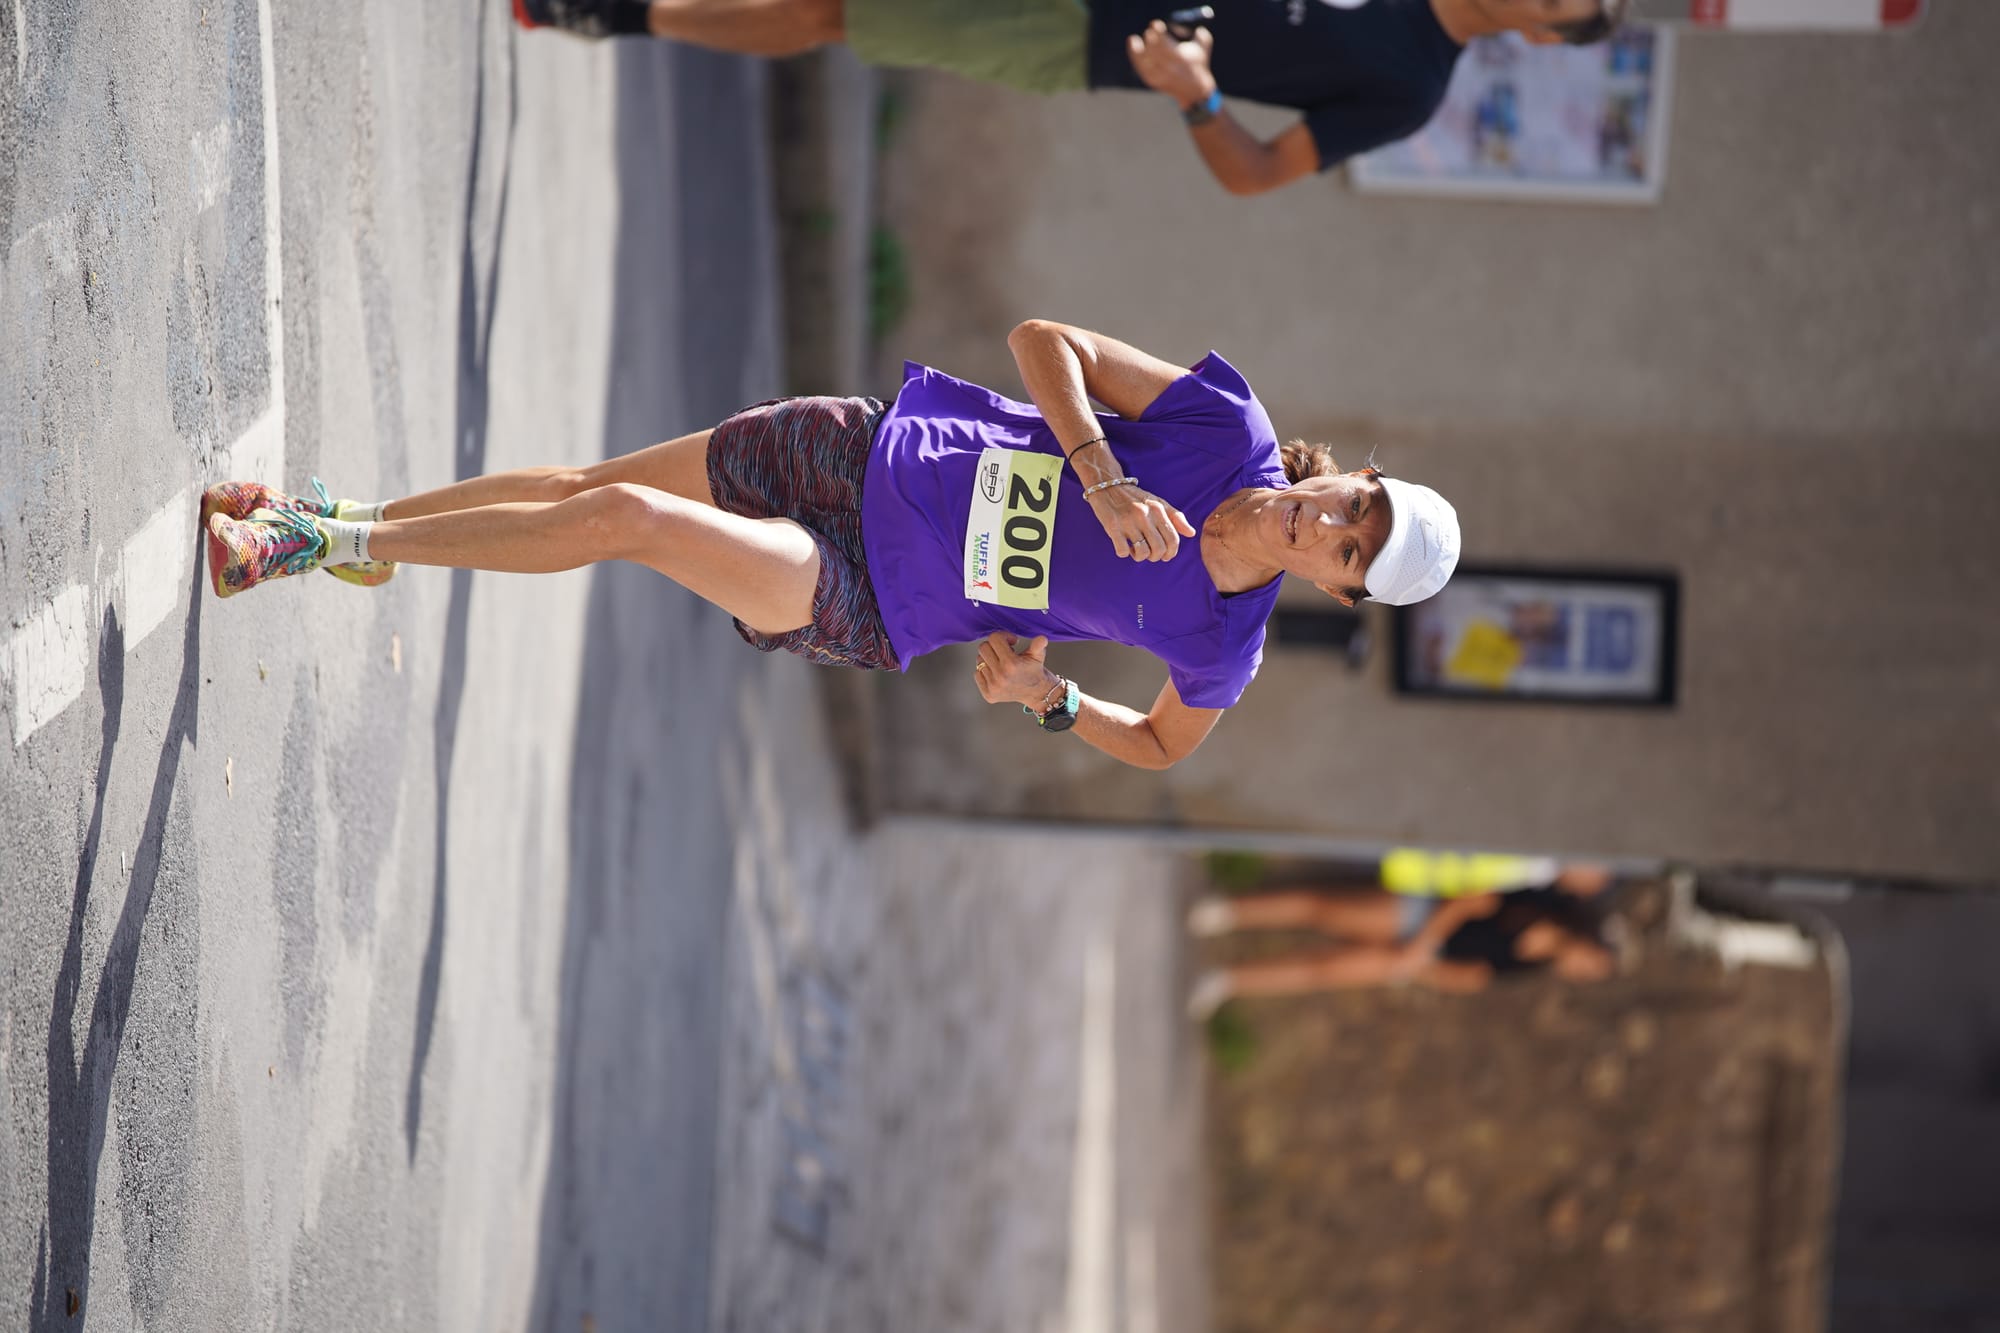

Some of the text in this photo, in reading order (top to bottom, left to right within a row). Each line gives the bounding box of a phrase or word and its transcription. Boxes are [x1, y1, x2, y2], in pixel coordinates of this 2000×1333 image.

[987, 463, 999, 498] BFP
[1001, 473, 1052, 589] 200
[973, 535, 982, 580] Aventure
[979, 532, 990, 577] TUFF'S
